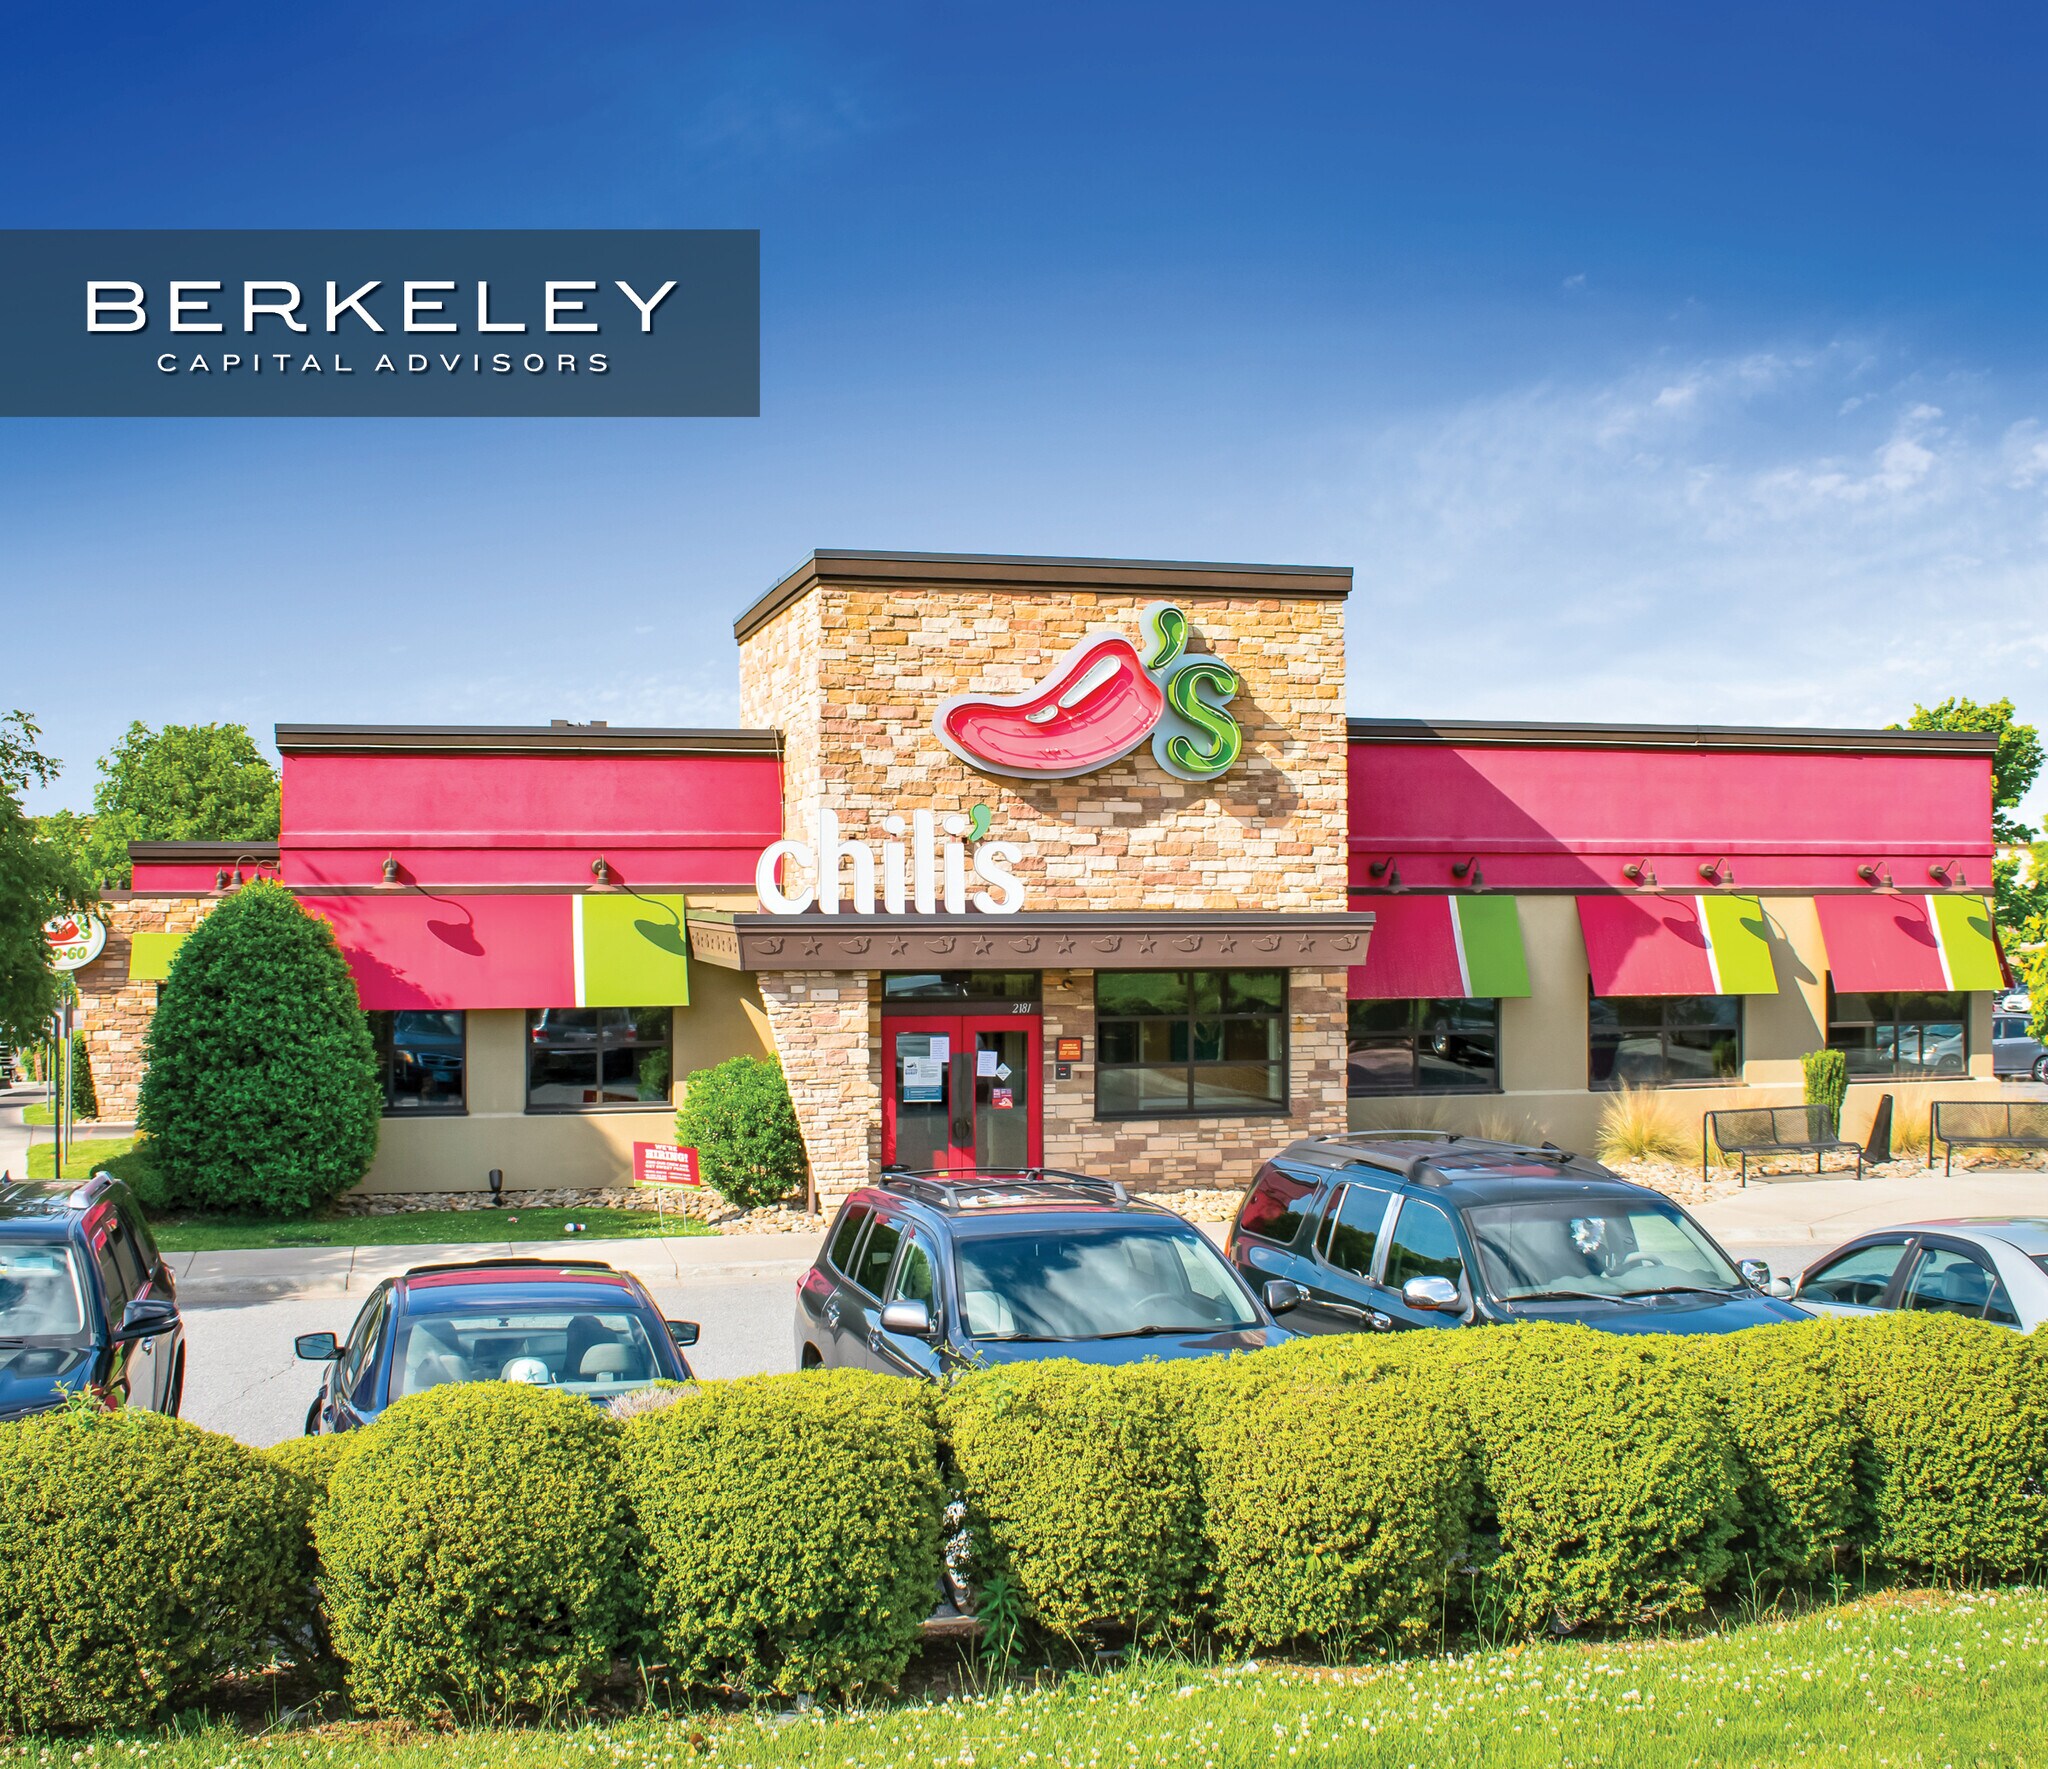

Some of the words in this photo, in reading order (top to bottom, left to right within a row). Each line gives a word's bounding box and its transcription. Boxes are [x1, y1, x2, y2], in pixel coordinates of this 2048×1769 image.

[755, 803, 1026, 916] chili's
[1012, 1003, 1032, 1014] 2181
[645, 1149, 689, 1163] HIRING!
